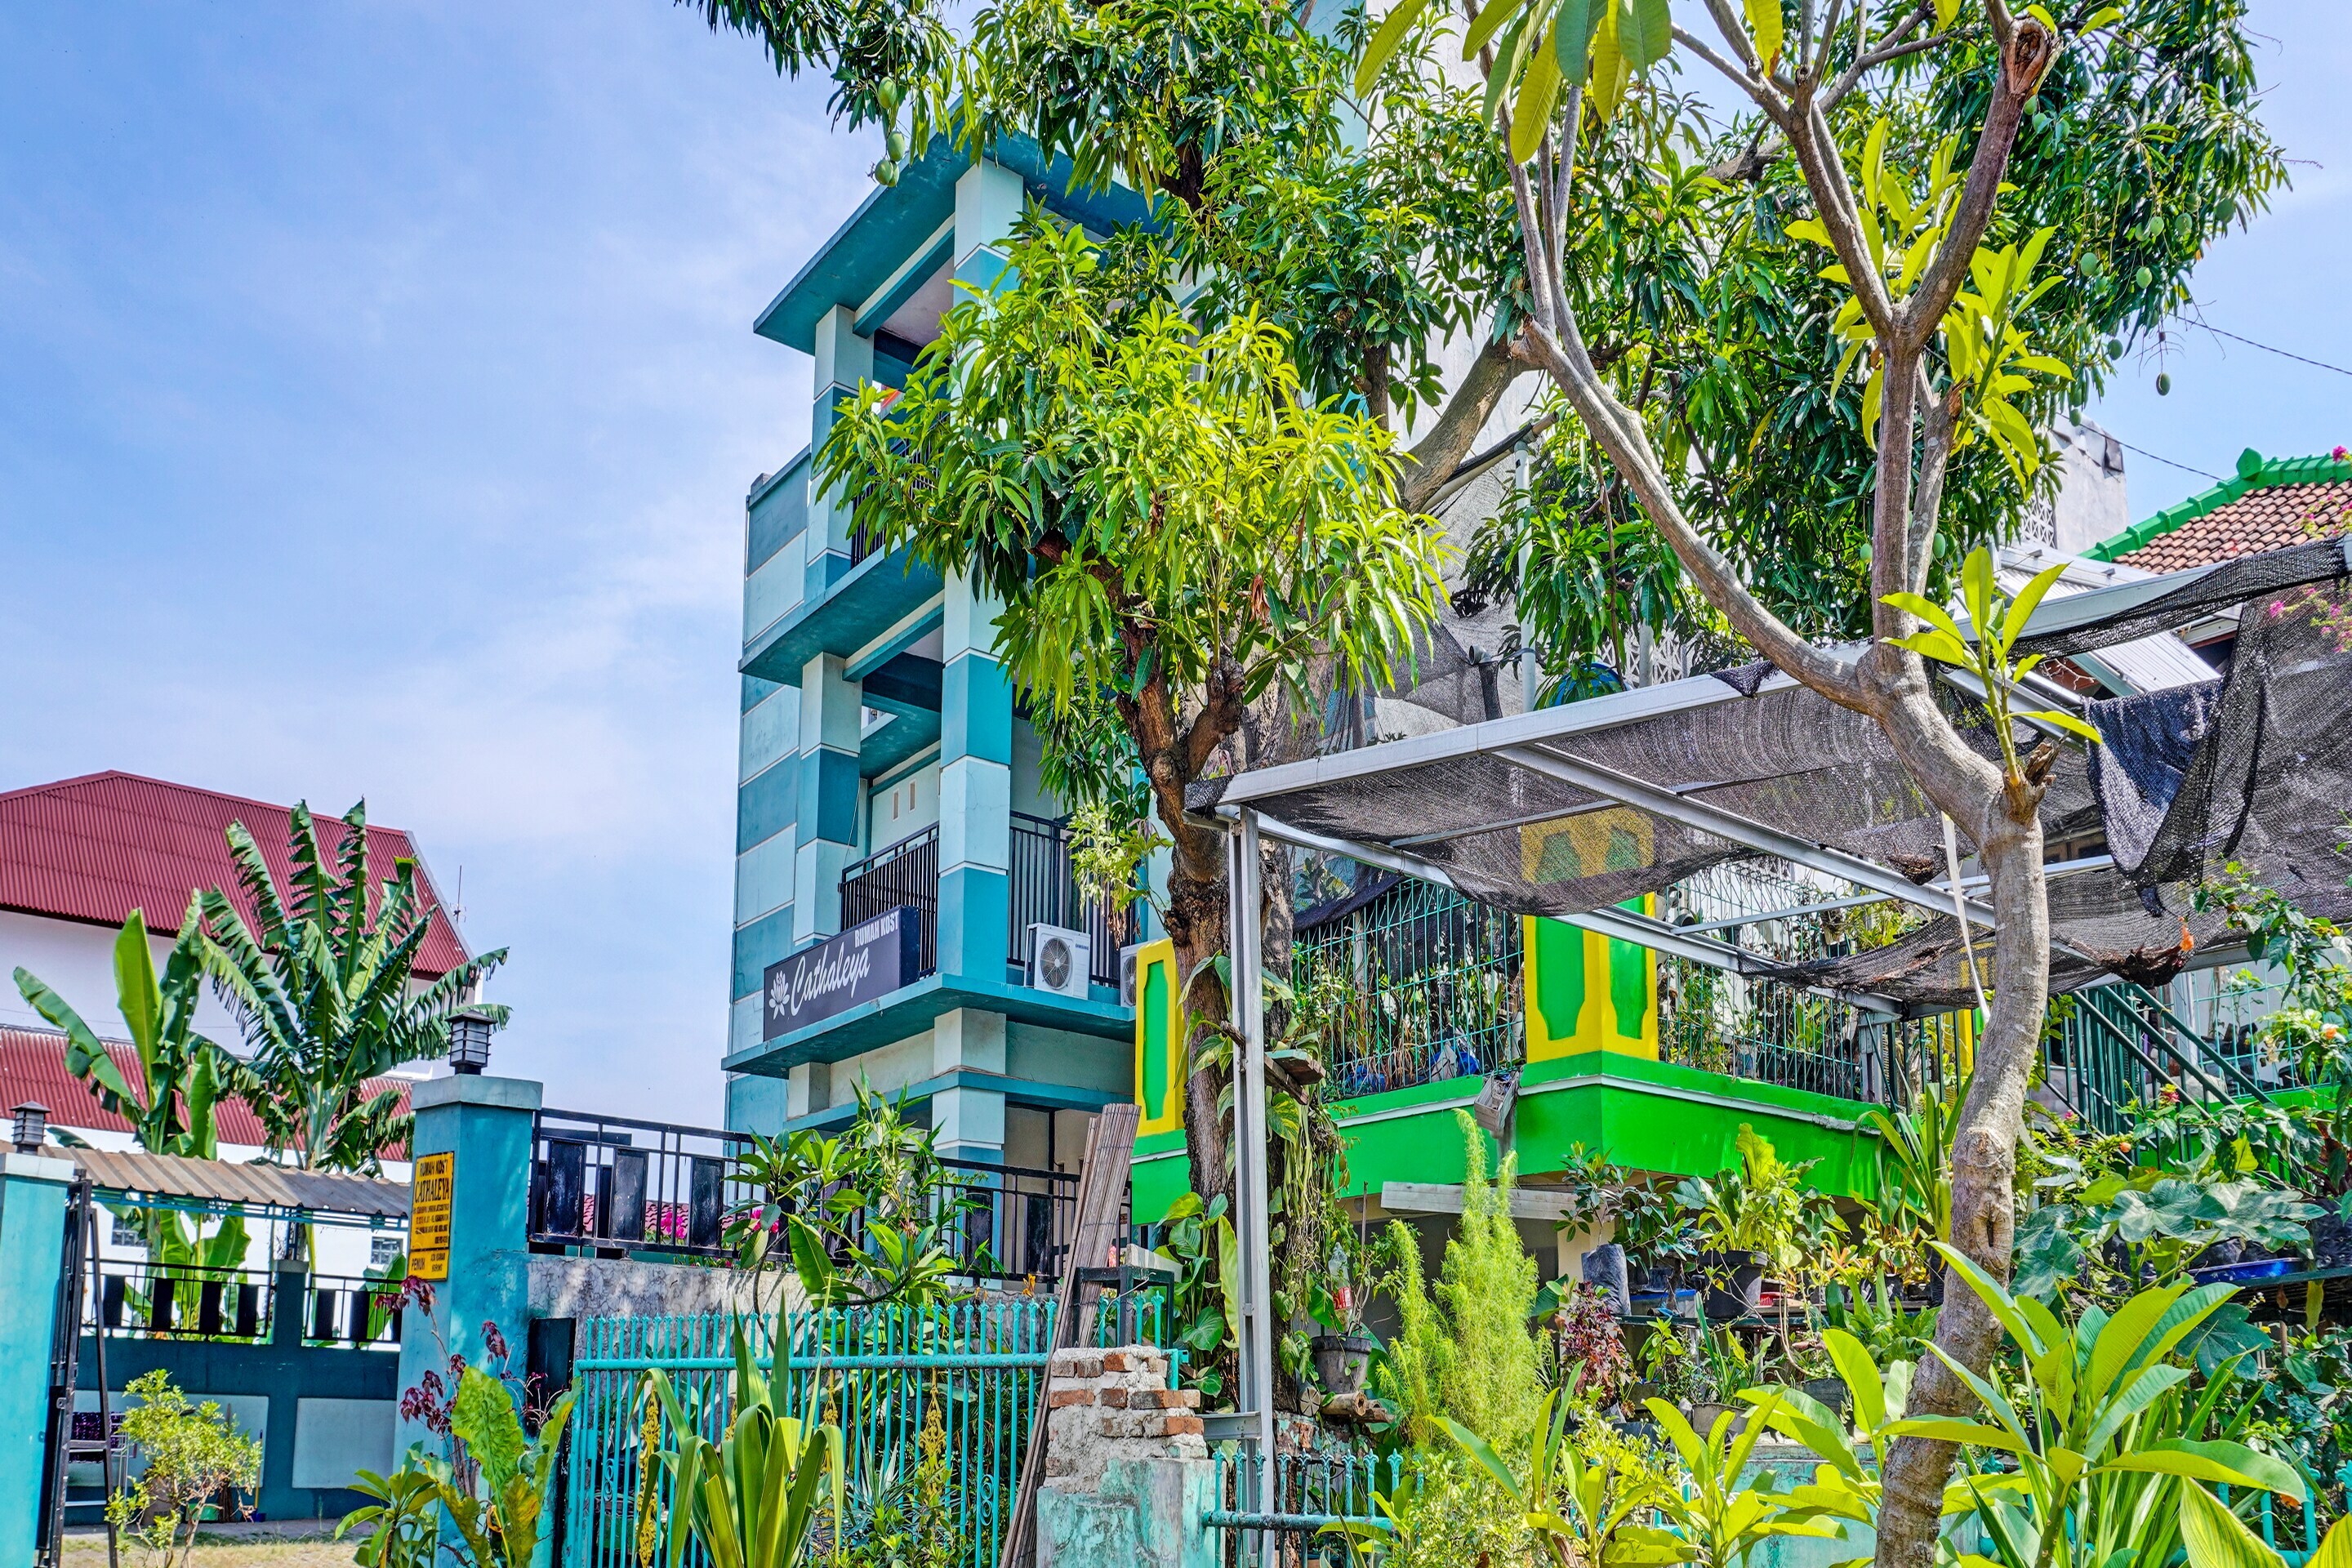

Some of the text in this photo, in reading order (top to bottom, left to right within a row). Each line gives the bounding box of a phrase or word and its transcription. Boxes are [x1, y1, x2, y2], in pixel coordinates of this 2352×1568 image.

[854, 911, 899, 948] RUMAH KOST
[791, 942, 871, 1017] Cathaleya
[420, 1160, 434, 1177] RUMAH
[415, 1177, 449, 1203] CATHALEYA
